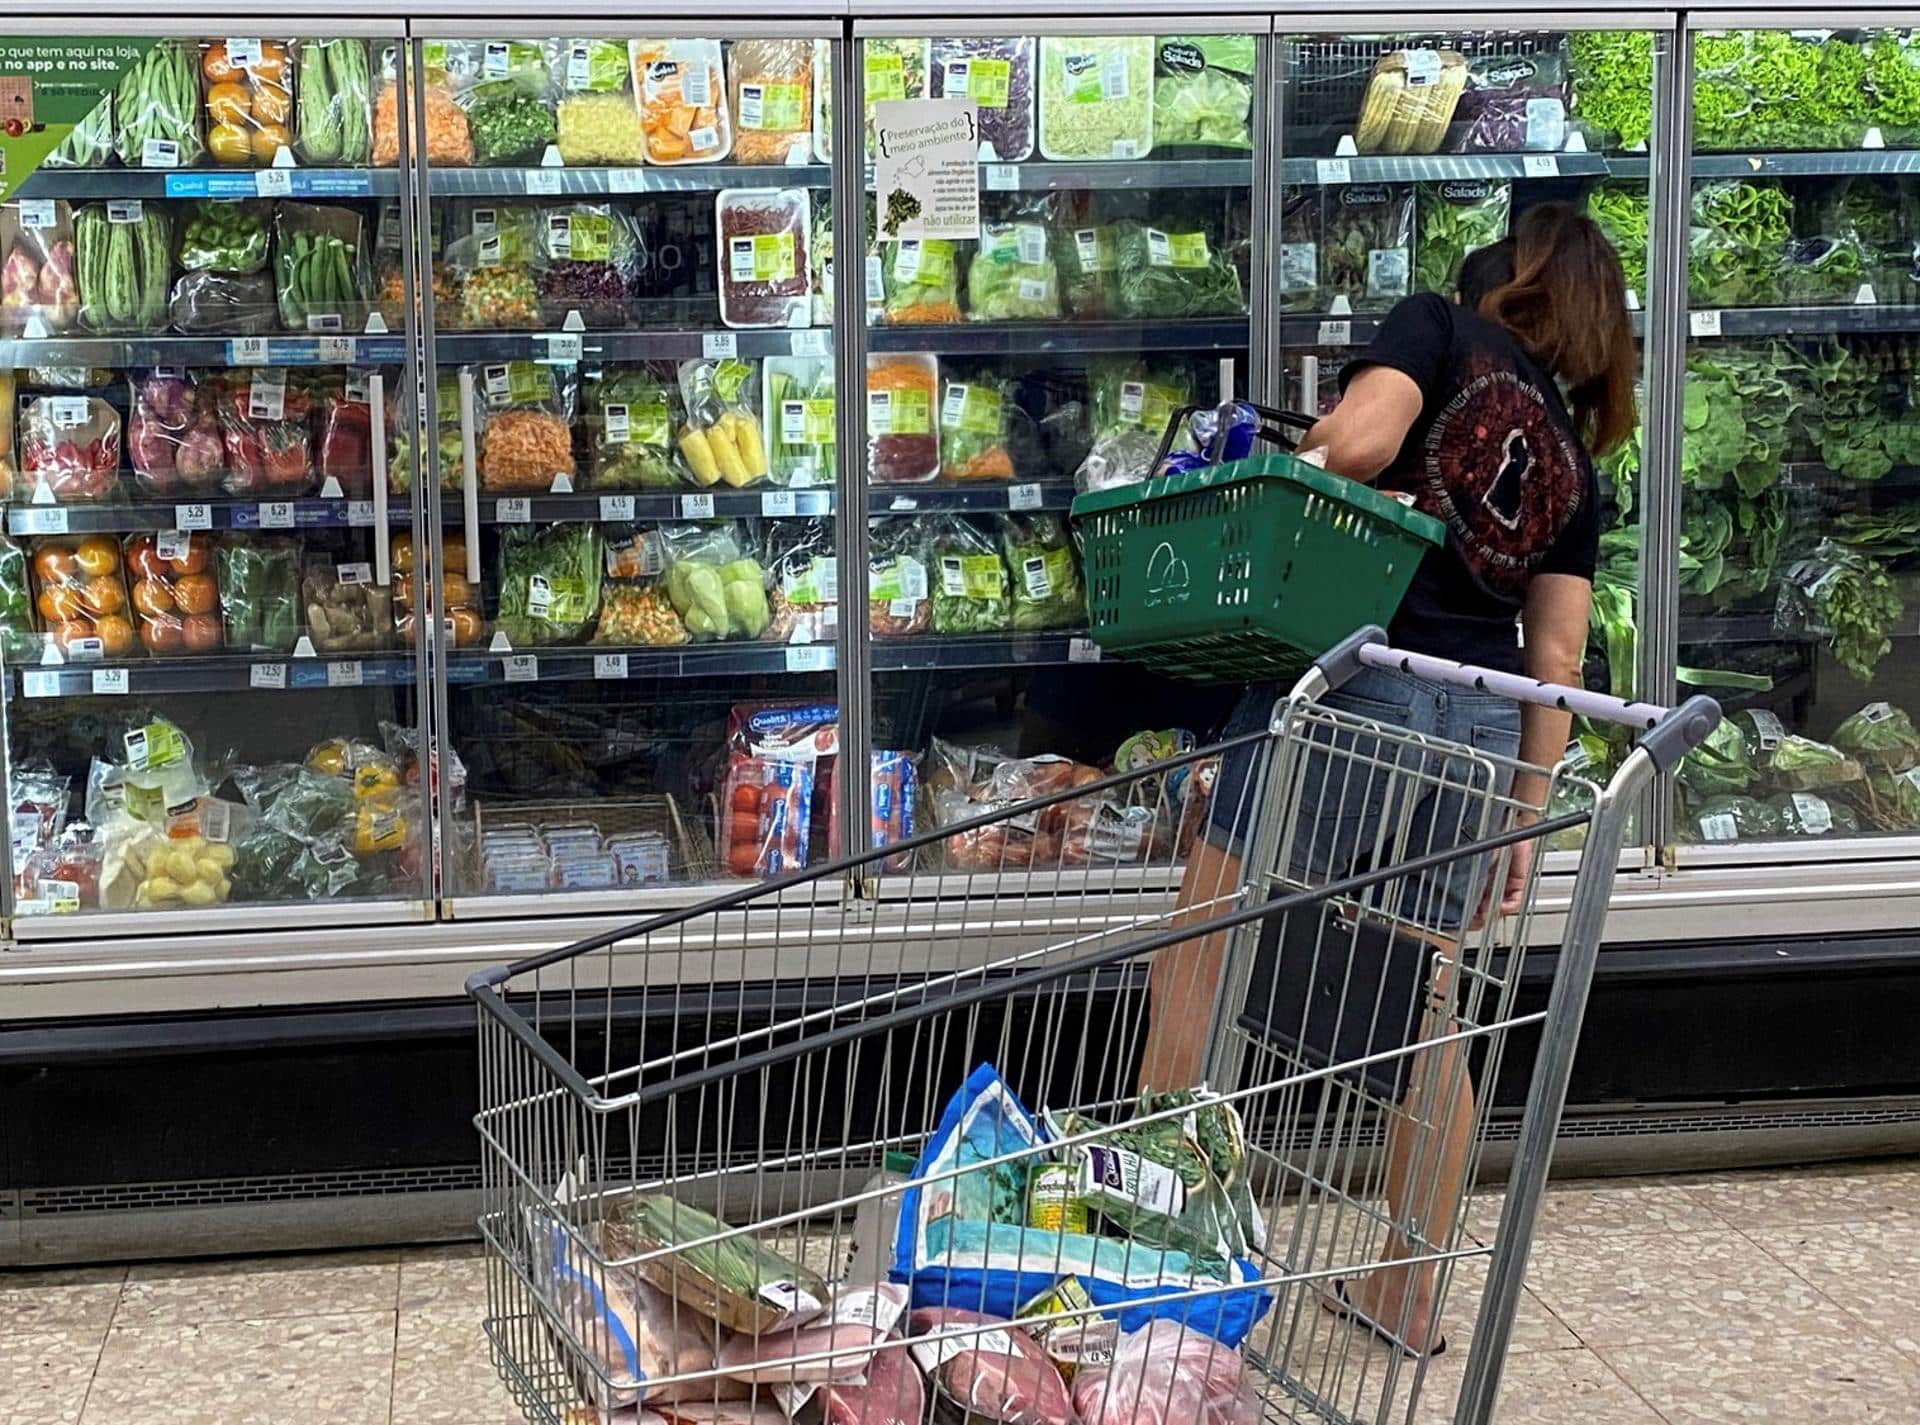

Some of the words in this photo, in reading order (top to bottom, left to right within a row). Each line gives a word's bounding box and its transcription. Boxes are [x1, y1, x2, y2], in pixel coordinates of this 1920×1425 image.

[8, 47, 34, 59] que
[36, 46, 63, 57] tem
[66, 46, 95, 59] aqui
[97, 47, 114, 57] na
[116, 45, 141, 60] loja,
[1163, 51, 1202, 69] Salads
[5, 60, 24, 70] no
[27, 60, 53, 72] app
[57, 60, 66, 70] e
[69, 60, 87, 70] no
[90, 58, 120, 70] site.
[1490, 66, 1534, 82] Salads
[886, 120, 949, 142] Preservação
[951, 117, 964, 129] do
[890, 143, 916, 154] meio
[918, 131, 967, 149] ambiente
[1444, 185, 1487, 199] Salads
[923, 214, 941, 225] não
[943, 213, 976, 225] utilizar
[187, 505, 204, 518] 5,29
